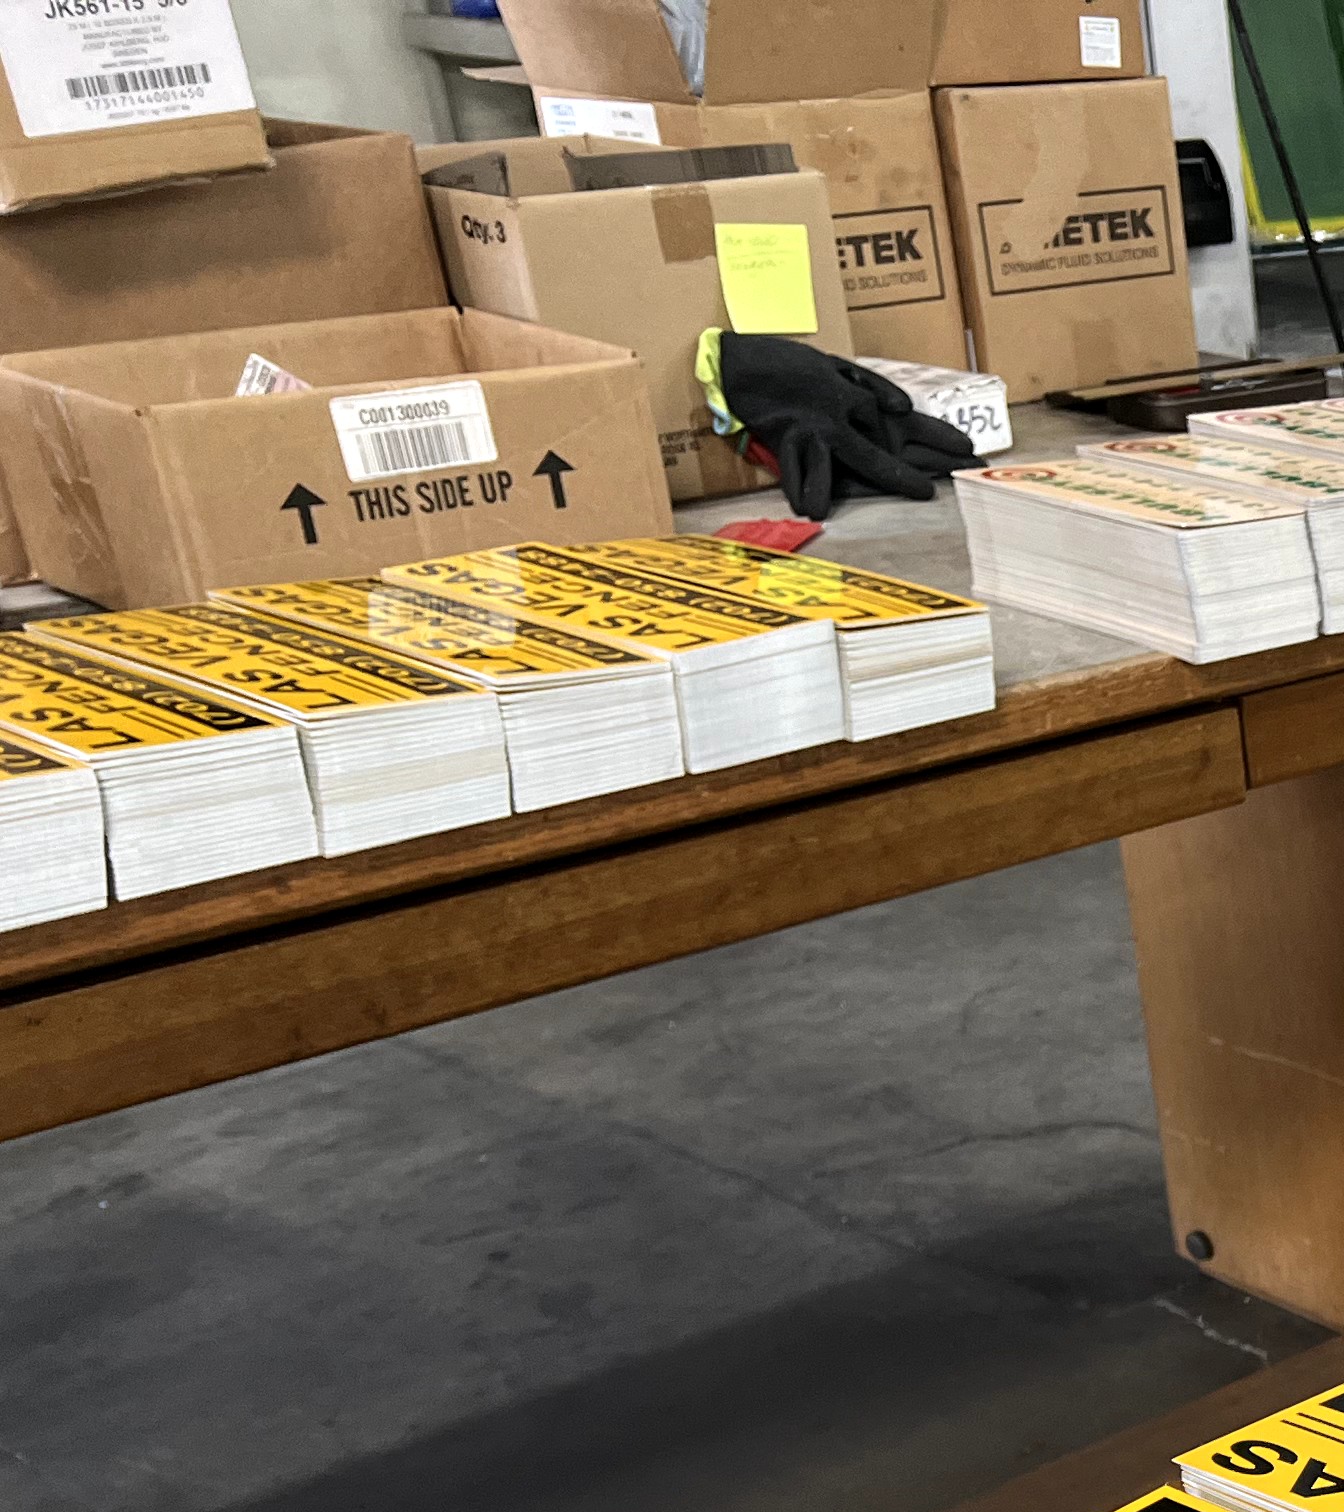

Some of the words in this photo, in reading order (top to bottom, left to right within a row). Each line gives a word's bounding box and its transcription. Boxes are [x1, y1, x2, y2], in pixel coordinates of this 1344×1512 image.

[348, 482, 409, 523] THIS
[414, 474, 475, 514] SIDE
[478, 469, 513, 504] UP
[596, 613, 716, 652] LAS
[0, 664, 135, 714] FENC
[224, 668, 357, 710] LAS
[10, 706, 143, 749] LAS
